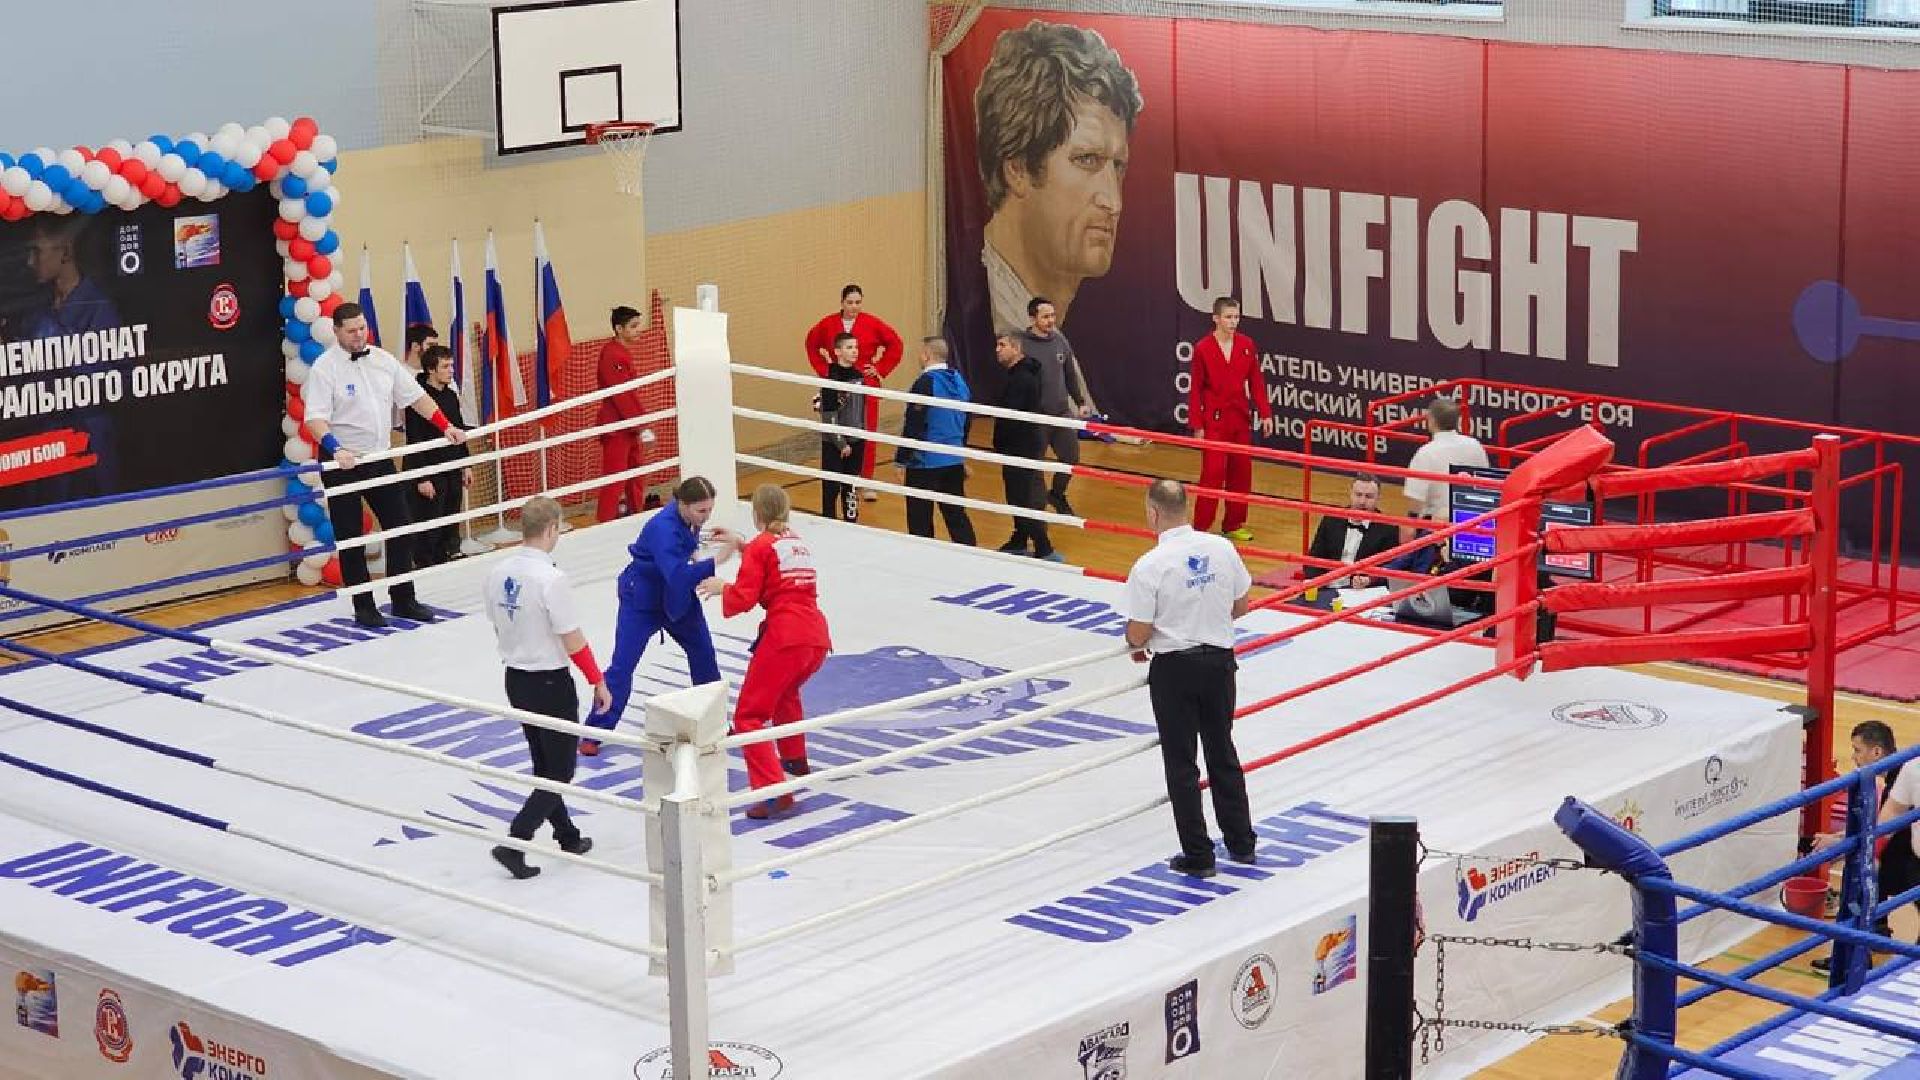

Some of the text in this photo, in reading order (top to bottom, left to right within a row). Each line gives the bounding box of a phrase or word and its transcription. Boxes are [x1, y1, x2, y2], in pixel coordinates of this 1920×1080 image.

[1175, 172, 1639, 367] UNIFIGHT
[0, 353, 229, 419] АЛЬНОГО ОКРУГА
[1176, 342, 1332, 383] ОАТЕЛЬ
[1175, 372, 1362, 420] ОИЙСКИЙ
[33, 441, 66, 464] БОЮ
[0, 841, 396, 967] UNIFIGHT
[207, 1040, 266, 1075] ЭНЕРГО
